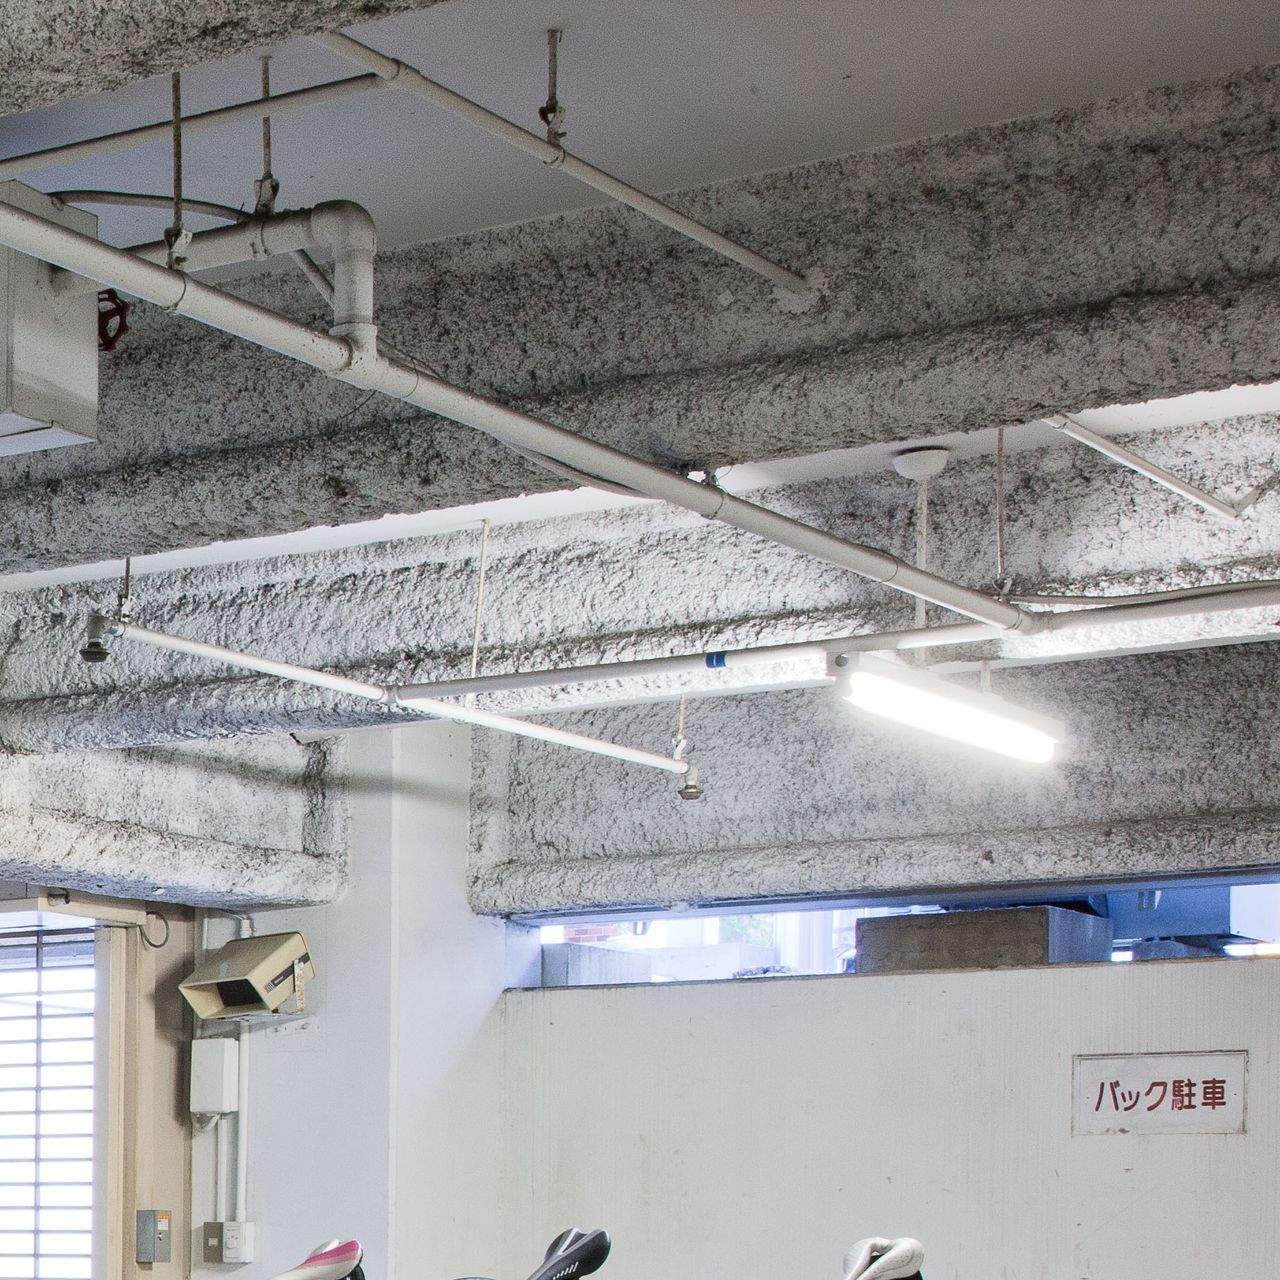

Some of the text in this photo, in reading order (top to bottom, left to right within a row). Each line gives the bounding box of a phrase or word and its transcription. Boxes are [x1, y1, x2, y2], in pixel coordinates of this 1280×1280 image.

[1095, 1078, 1226, 1112] バック駐車
